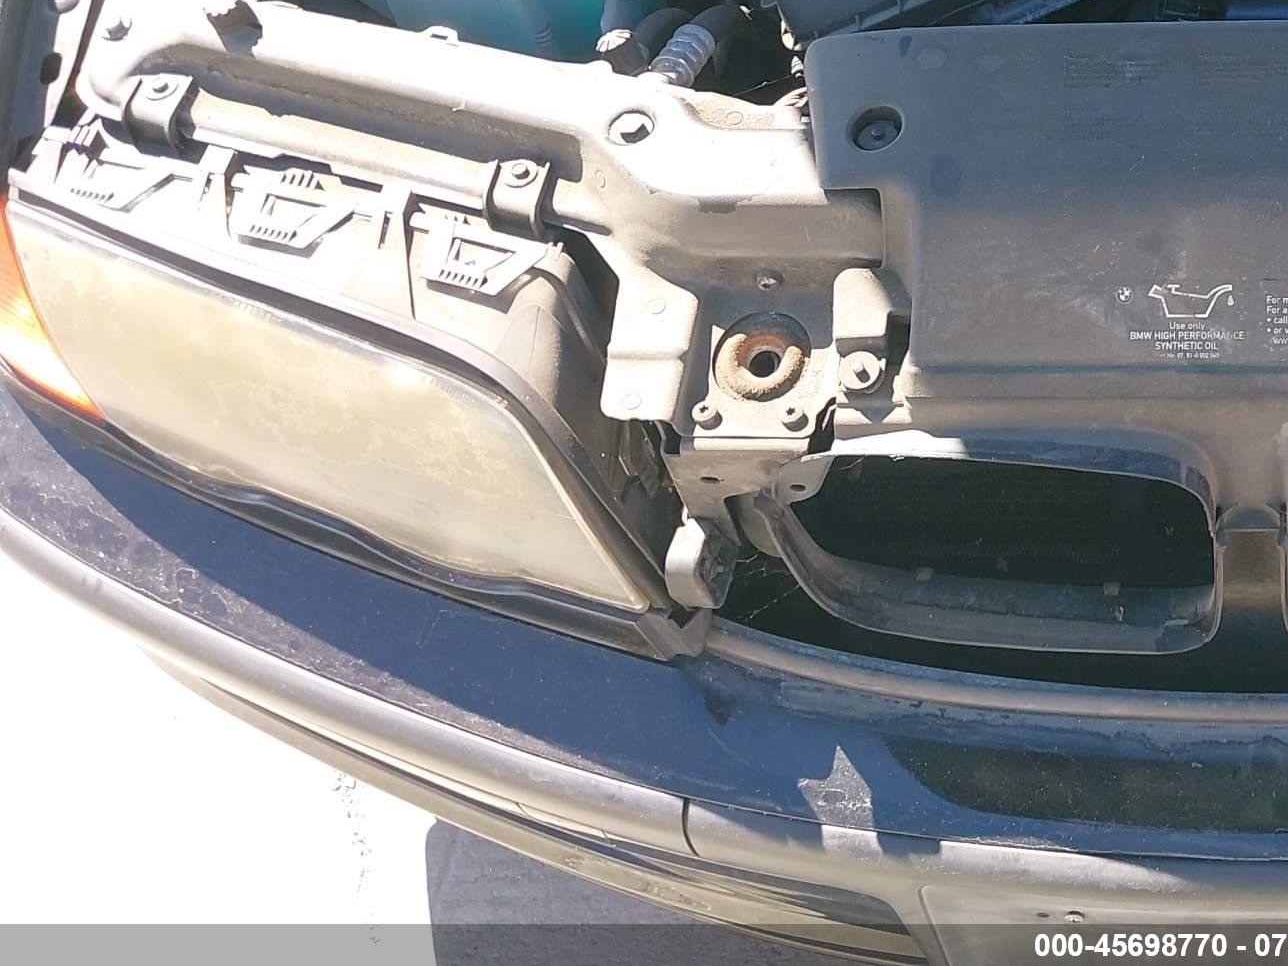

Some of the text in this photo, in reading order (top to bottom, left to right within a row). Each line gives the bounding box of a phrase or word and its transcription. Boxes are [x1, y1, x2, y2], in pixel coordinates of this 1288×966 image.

[1266, 295, 1281, 304] For
[1266, 306, 1281, 314] For
[1273, 316, 1288, 324] call
[1169, 321, 1206, 331] Use only
[1129, 331, 1152, 340] BMW
[1154, 331, 1176, 340] HIGH
[1155, 341, 1219, 350] SYNTHETIC OIL
